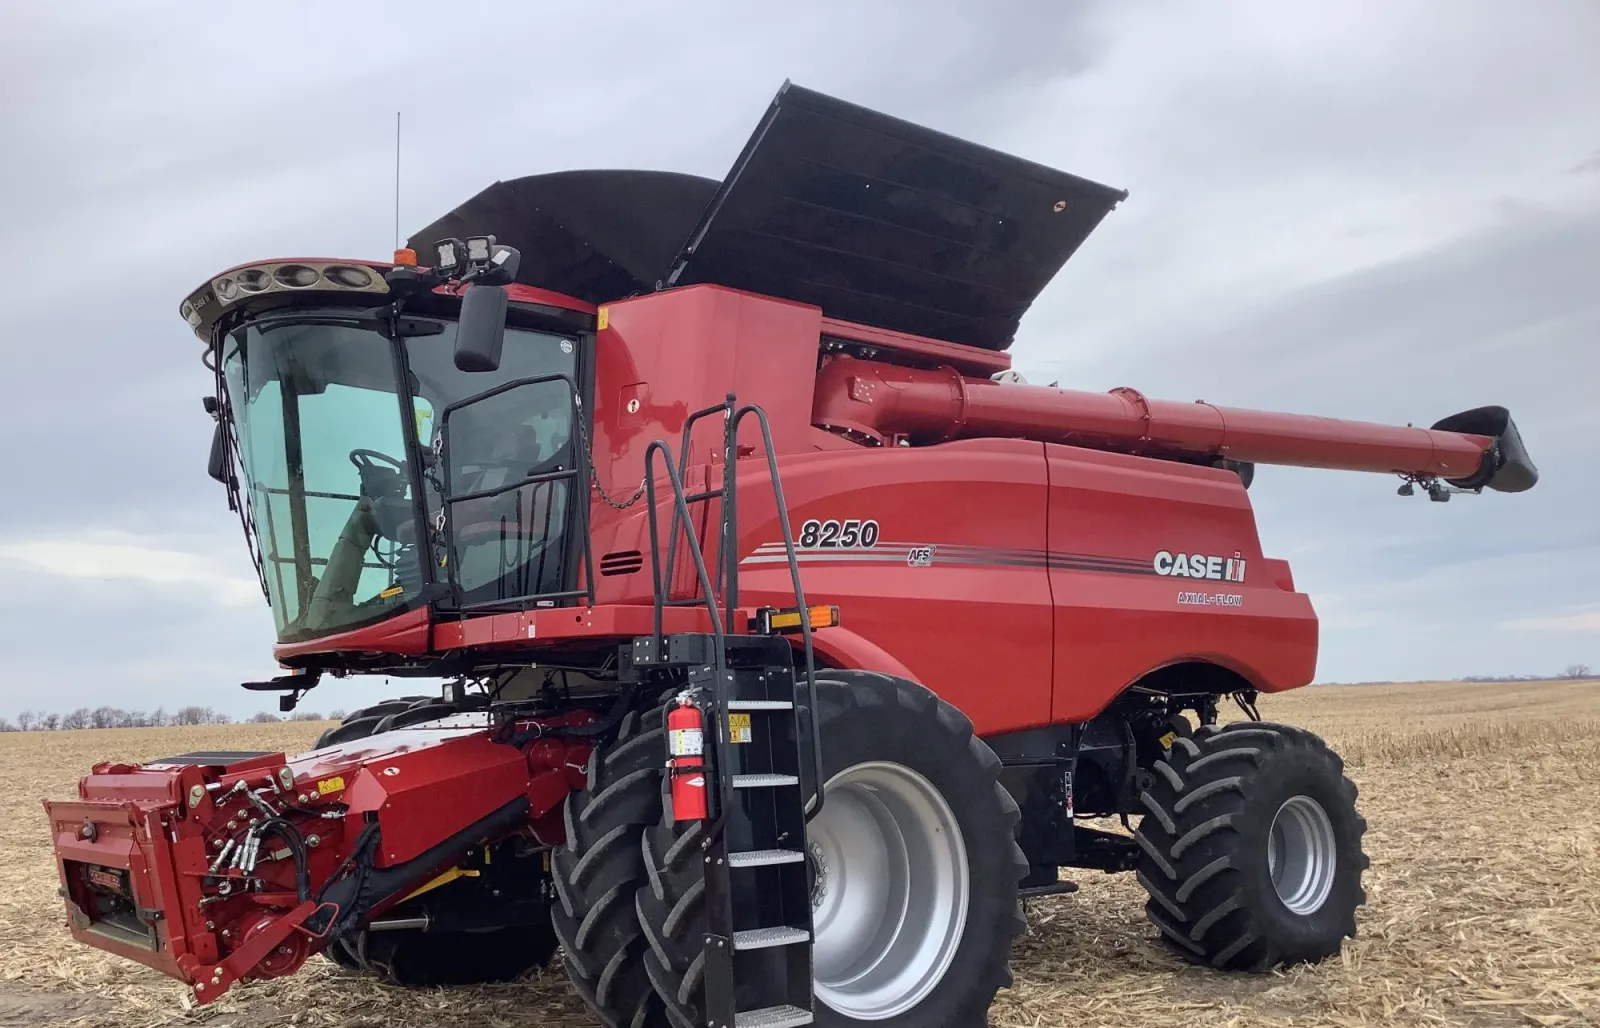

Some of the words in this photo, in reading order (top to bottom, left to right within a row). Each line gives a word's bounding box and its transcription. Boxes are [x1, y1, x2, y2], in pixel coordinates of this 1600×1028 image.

[799, 519, 879, 549] 8250
[907, 547, 931, 561] AFS
[1153, 550, 1223, 579] CASE
[1177, 591, 1242, 606] AXIAL-FLOW
